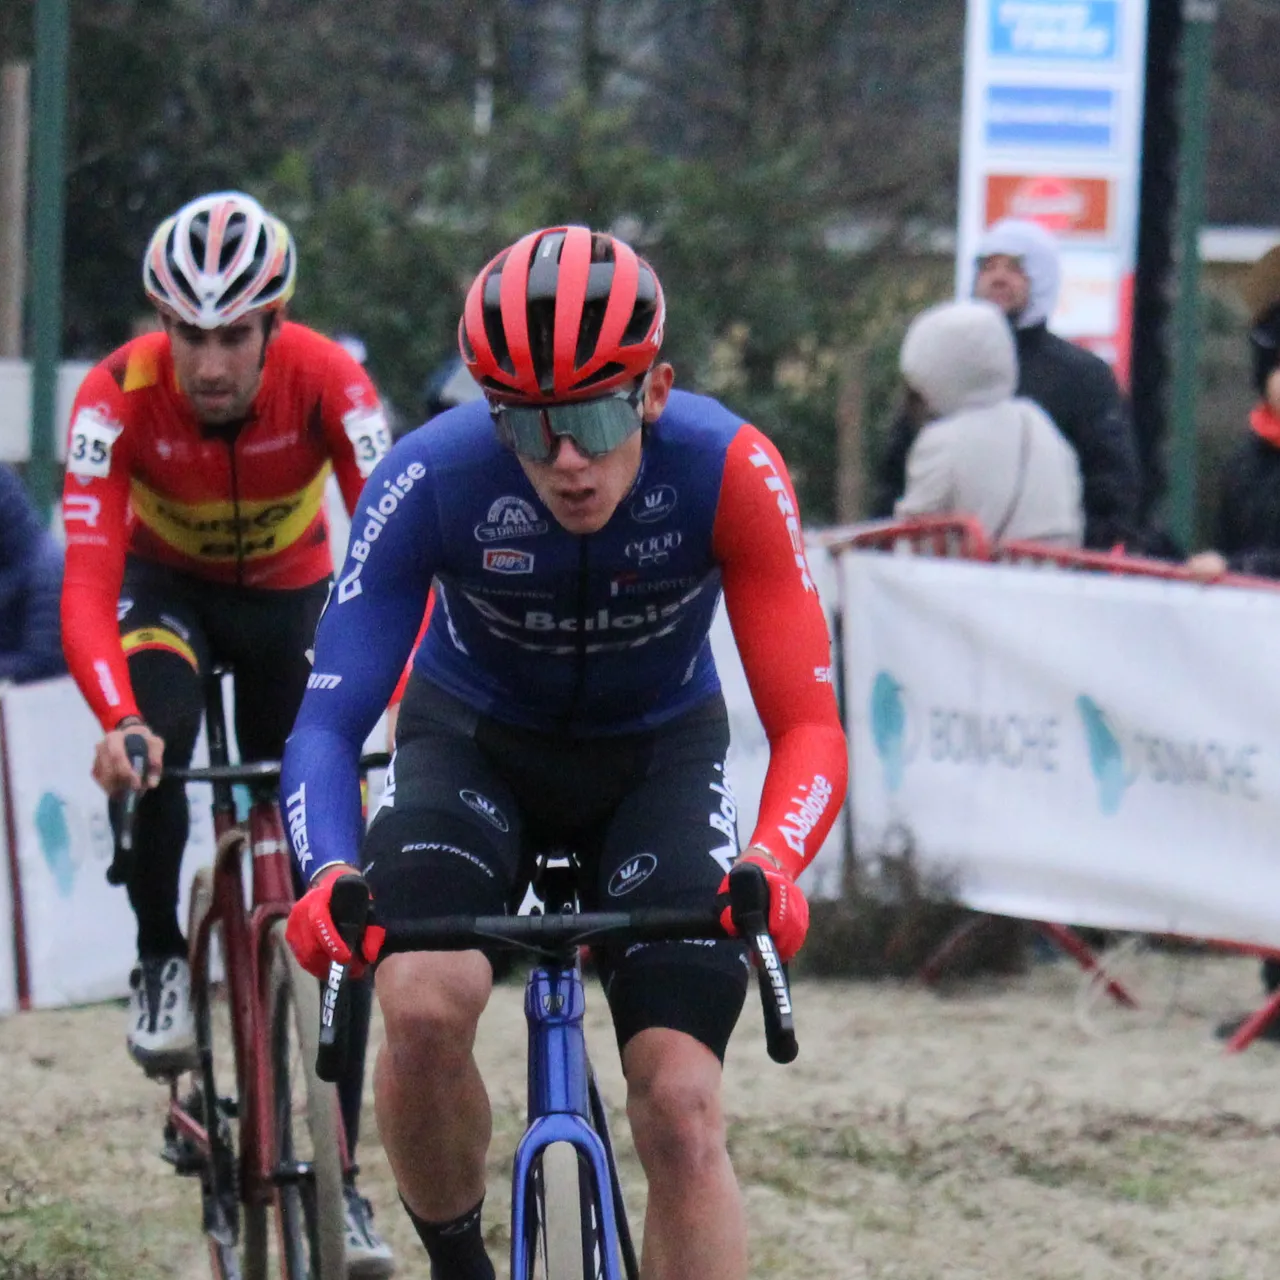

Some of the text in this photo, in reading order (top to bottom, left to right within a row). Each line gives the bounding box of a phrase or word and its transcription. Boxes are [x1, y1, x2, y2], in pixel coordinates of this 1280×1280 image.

[72, 433, 107, 464] 35
[350, 462, 426, 563] Baloise
[286, 782, 313, 872] TREK
[756, 934, 792, 1014] SRAM
